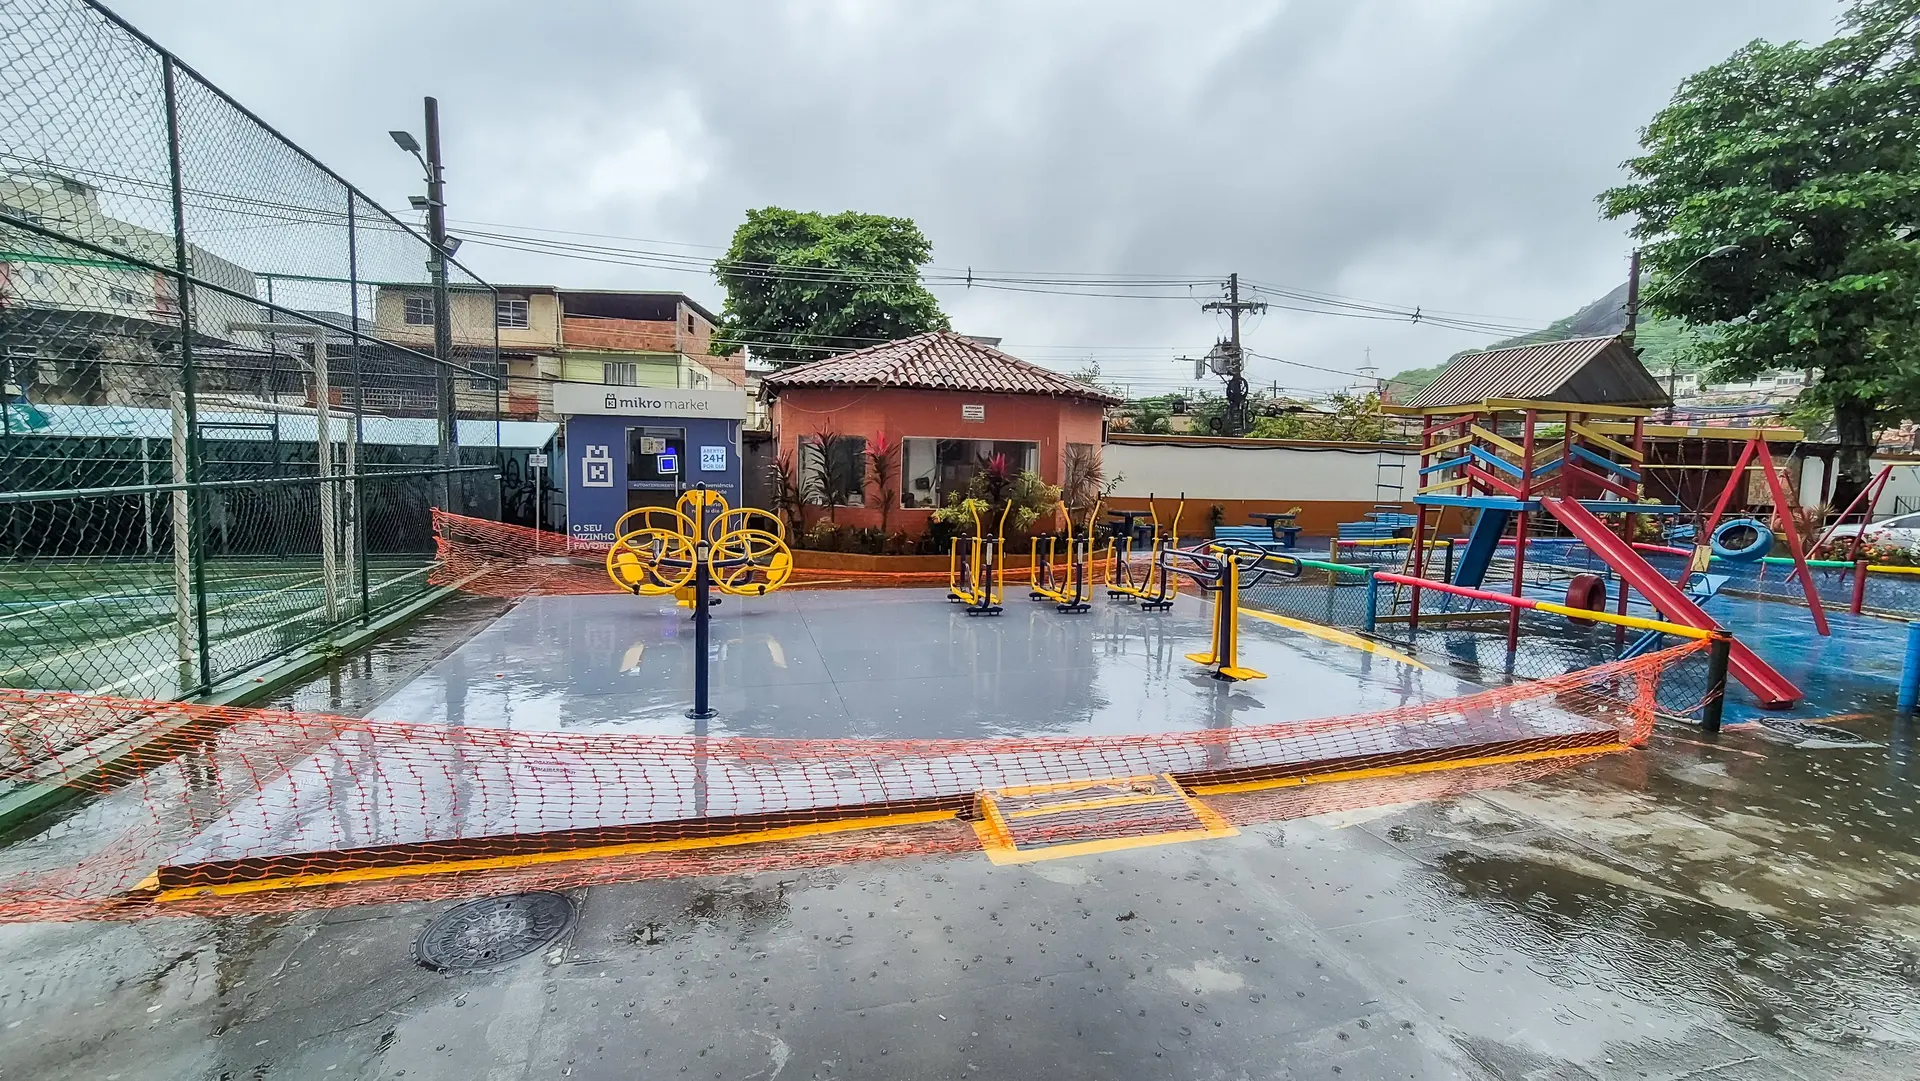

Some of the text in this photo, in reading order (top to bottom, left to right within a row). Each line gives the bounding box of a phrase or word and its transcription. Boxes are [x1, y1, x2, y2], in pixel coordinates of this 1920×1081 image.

[619, 397, 662, 409] mikro
[664, 399, 709, 411] market
[703, 454, 725, 462] 24H
[573, 524, 602, 532] O SEU
[573, 533, 615, 541] VIZINHO
[574, 542, 615, 550] FAVORIT
